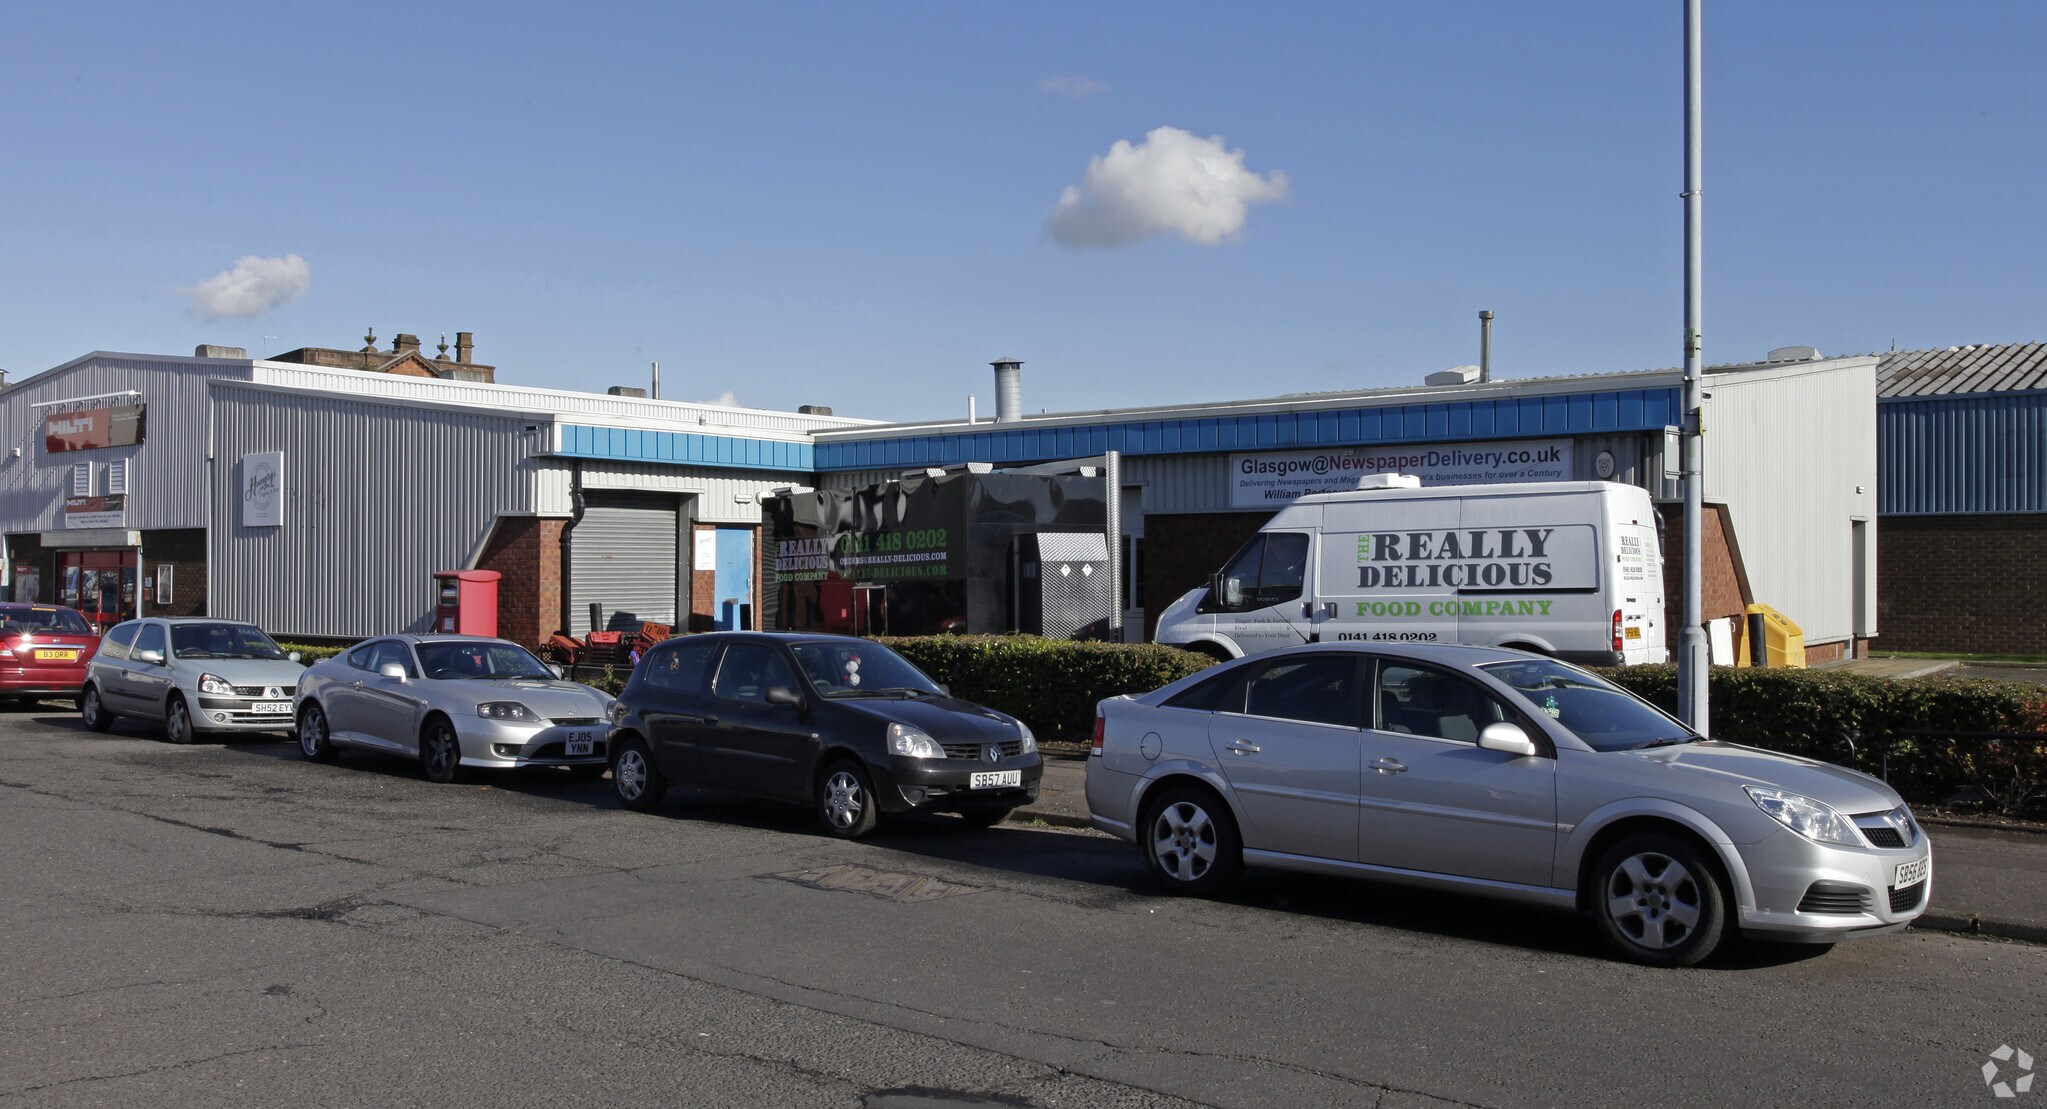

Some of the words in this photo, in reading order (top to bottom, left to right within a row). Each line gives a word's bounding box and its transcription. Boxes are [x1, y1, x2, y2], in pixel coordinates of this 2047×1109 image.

[49, 417, 93, 435] HILTI
[1241, 446, 1560, 476] Glasgow@NewspaperDelivery.co.uk
[1240, 479, 1275, 488] Delivering
[1277, 478, 1322, 486] Newspapers
[1324, 476, 1338, 484] and
[1436, 472, 1482, 481] businesses
[1484, 470, 1497, 479] for
[1528, 469, 1562, 479] Century
[1264, 489, 1300, 499] William
[779, 538, 829, 557] REALLY
[876, 532, 901, 551] 418
[906, 528, 947, 550] 0202
[1371, 529, 1554, 562] REALLY
[1357, 534, 1370, 563] THE
[775, 555, 829, 572] DELICIOUS
[775, 573, 794, 583] FOOD
[795, 571, 829, 581] COMPANY
[1357, 562, 1553, 588] DELICIOUS
[1356, 601, 1422, 616] FOOD
[1429, 600, 1554, 616] COMPANY
[1338, 632, 1367, 641] 0141
[1373, 632, 1397, 641] 418
[1400, 632, 1438, 642] 0202
[255, 703, 278, 712] SH52
[568, 731, 592, 743] EJ05
[571, 743, 589, 754] YNN
[975, 774, 1000, 787] SB57
[1002, 772, 1018, 785] AUU
[1898, 862, 1918, 884] SB56
